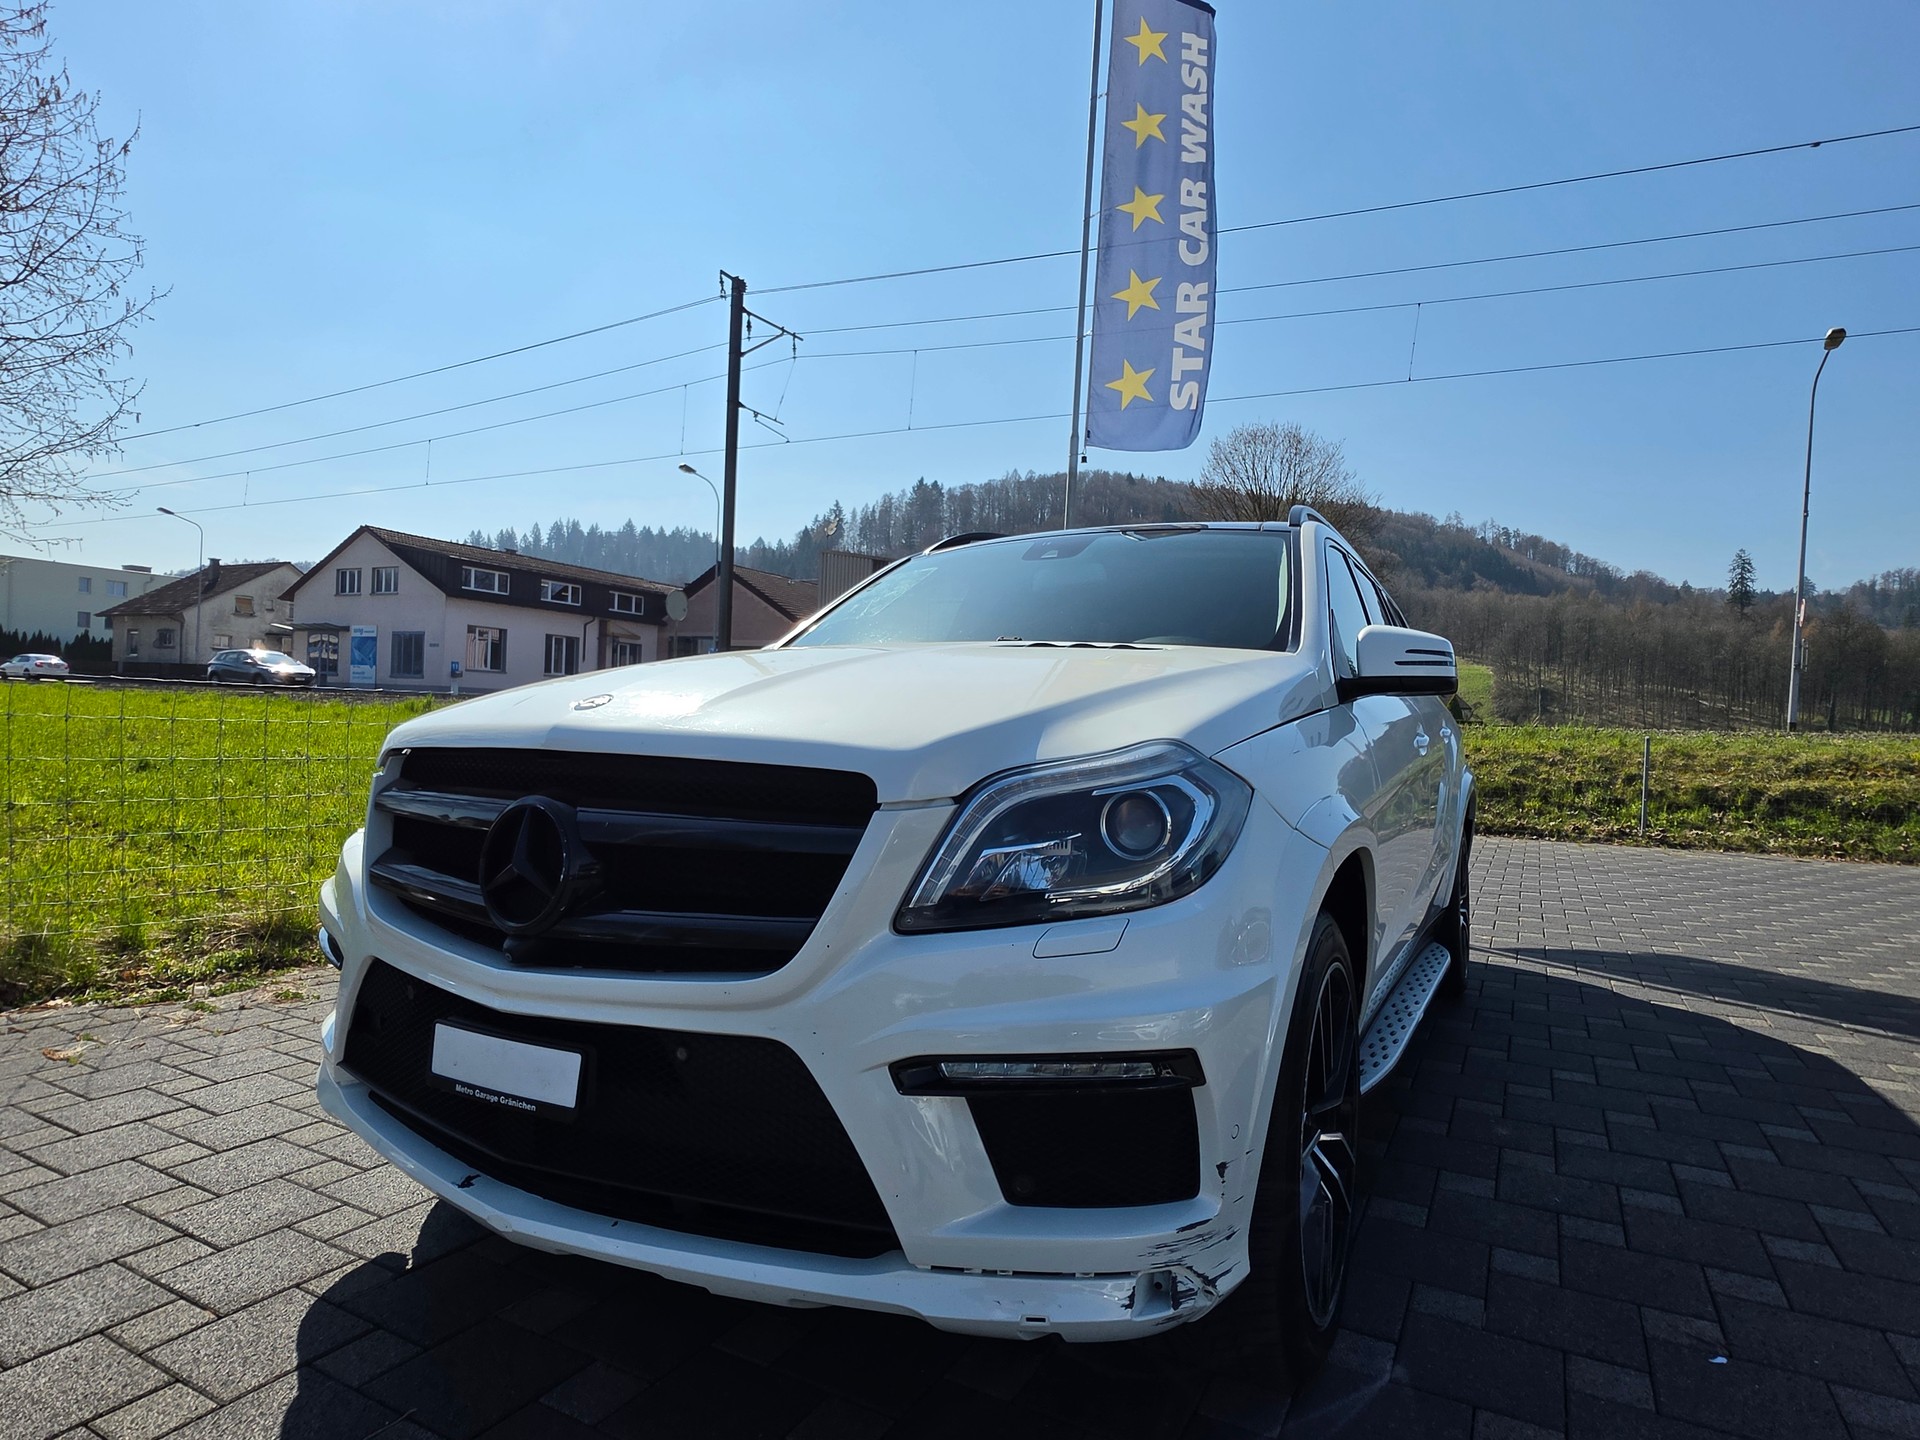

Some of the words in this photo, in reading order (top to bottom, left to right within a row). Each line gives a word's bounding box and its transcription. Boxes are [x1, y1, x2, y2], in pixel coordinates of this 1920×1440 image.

[1180, 32, 1208, 163] WASH
[1178, 178, 1209, 266] CAR
[1169, 281, 1209, 411] STAR
[455, 1083, 474, 1096] Metro
[474, 1089, 499, 1103] Garage
[499, 1095, 537, 1112] Gränichen
